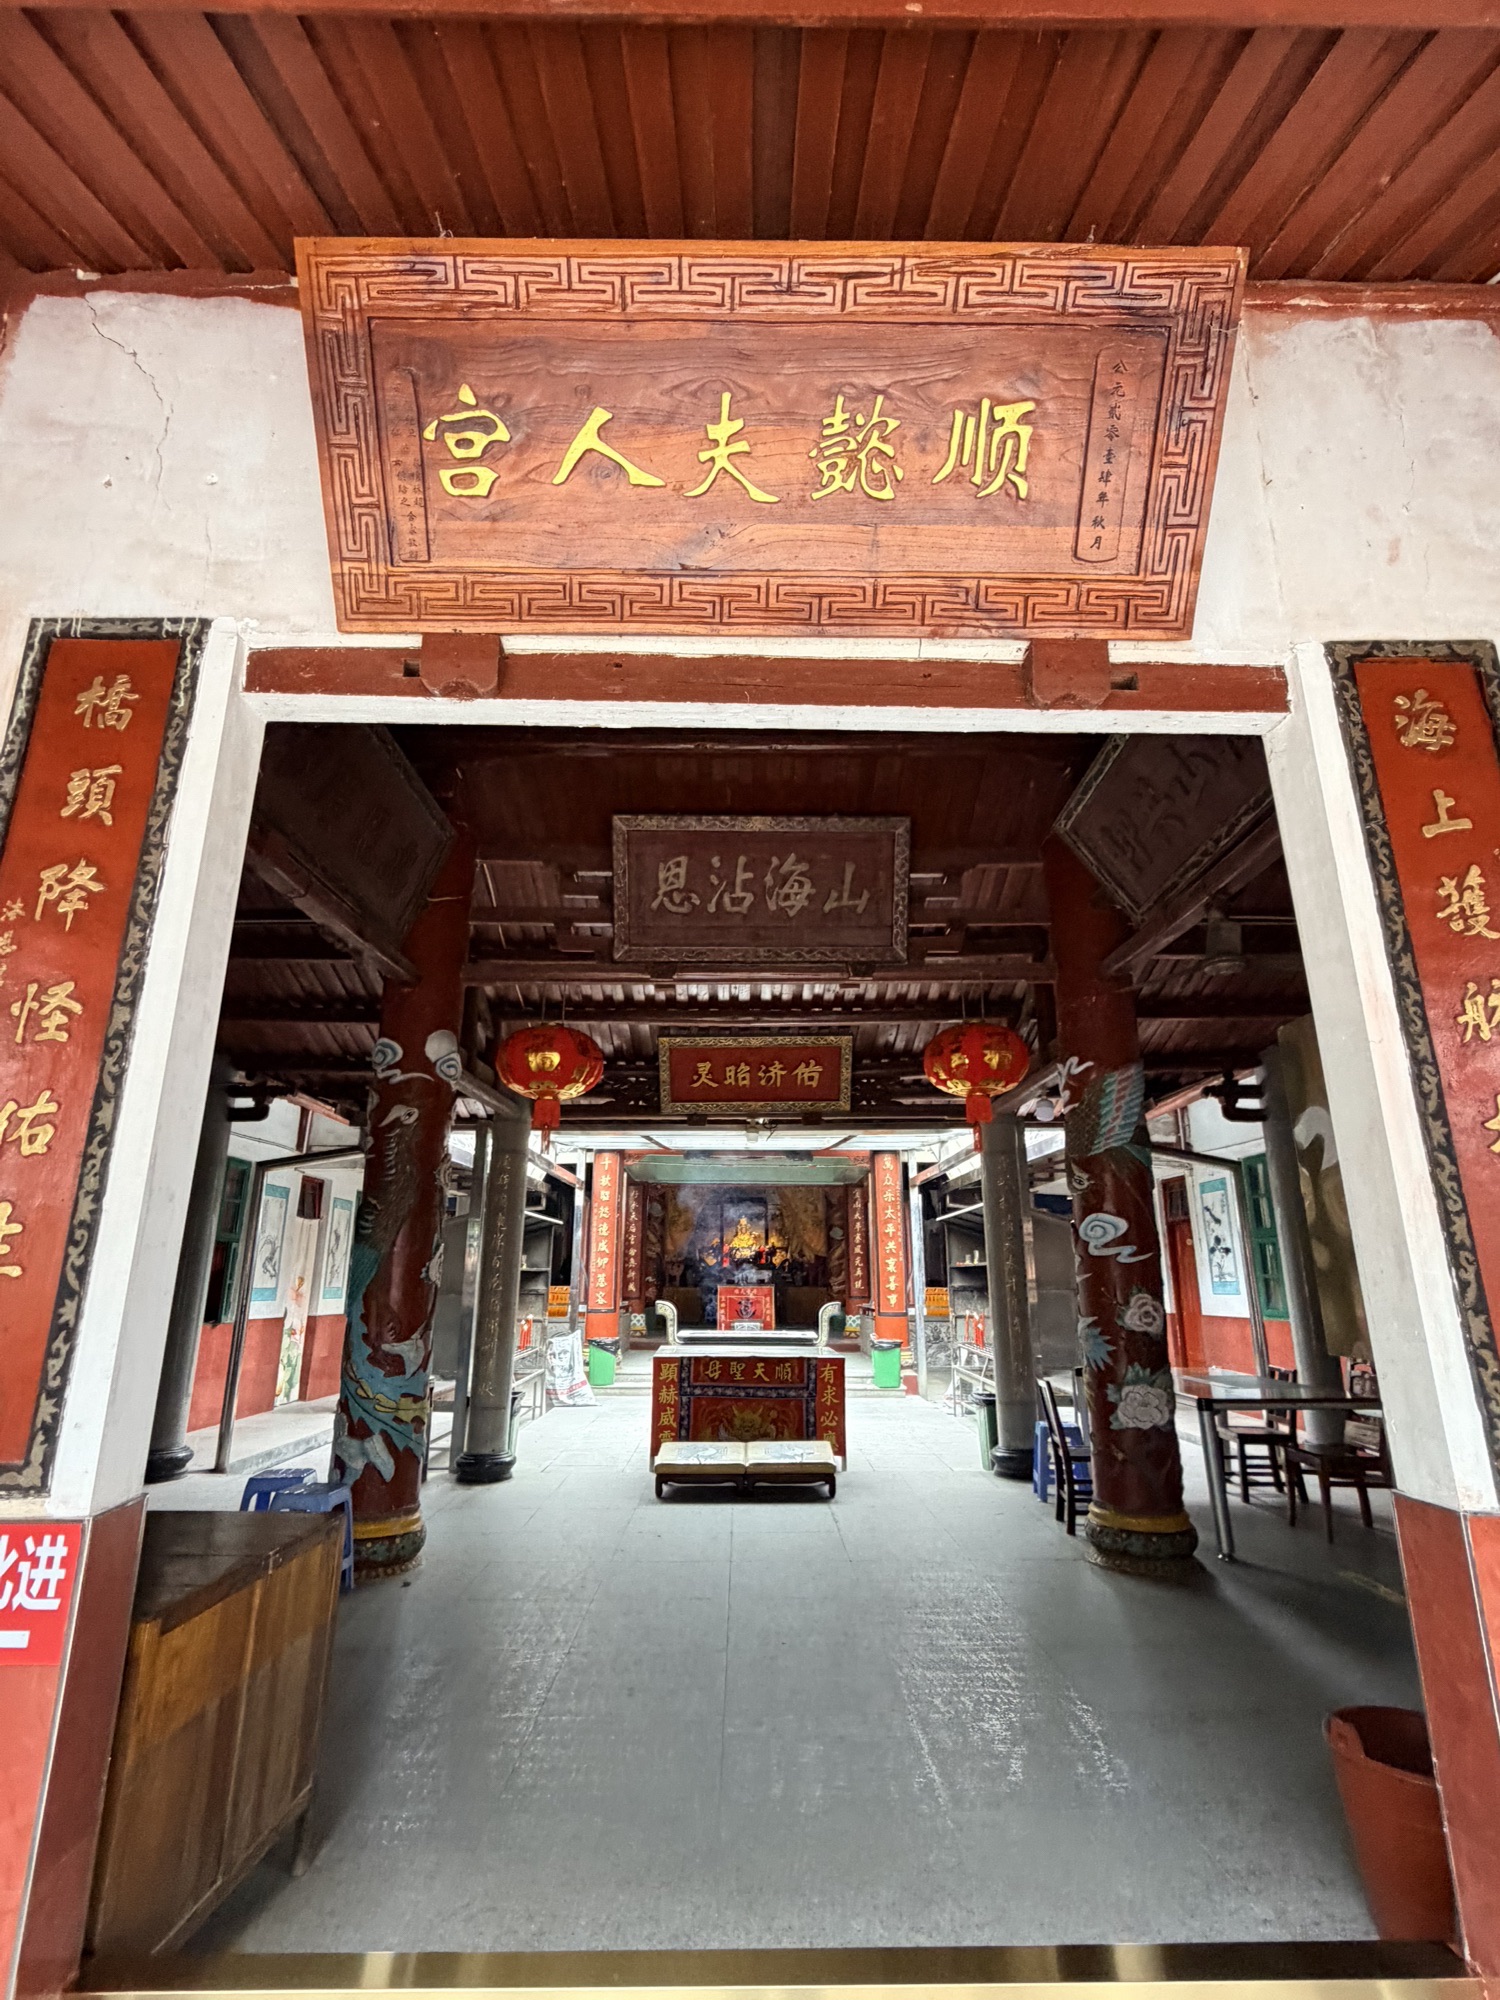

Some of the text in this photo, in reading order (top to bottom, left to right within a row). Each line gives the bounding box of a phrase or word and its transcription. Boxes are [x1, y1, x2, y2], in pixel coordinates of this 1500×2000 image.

[423, 383, 1036, 503] 顺懿夫人宫
[1394, 688, 1500, 1153] 海上護航
